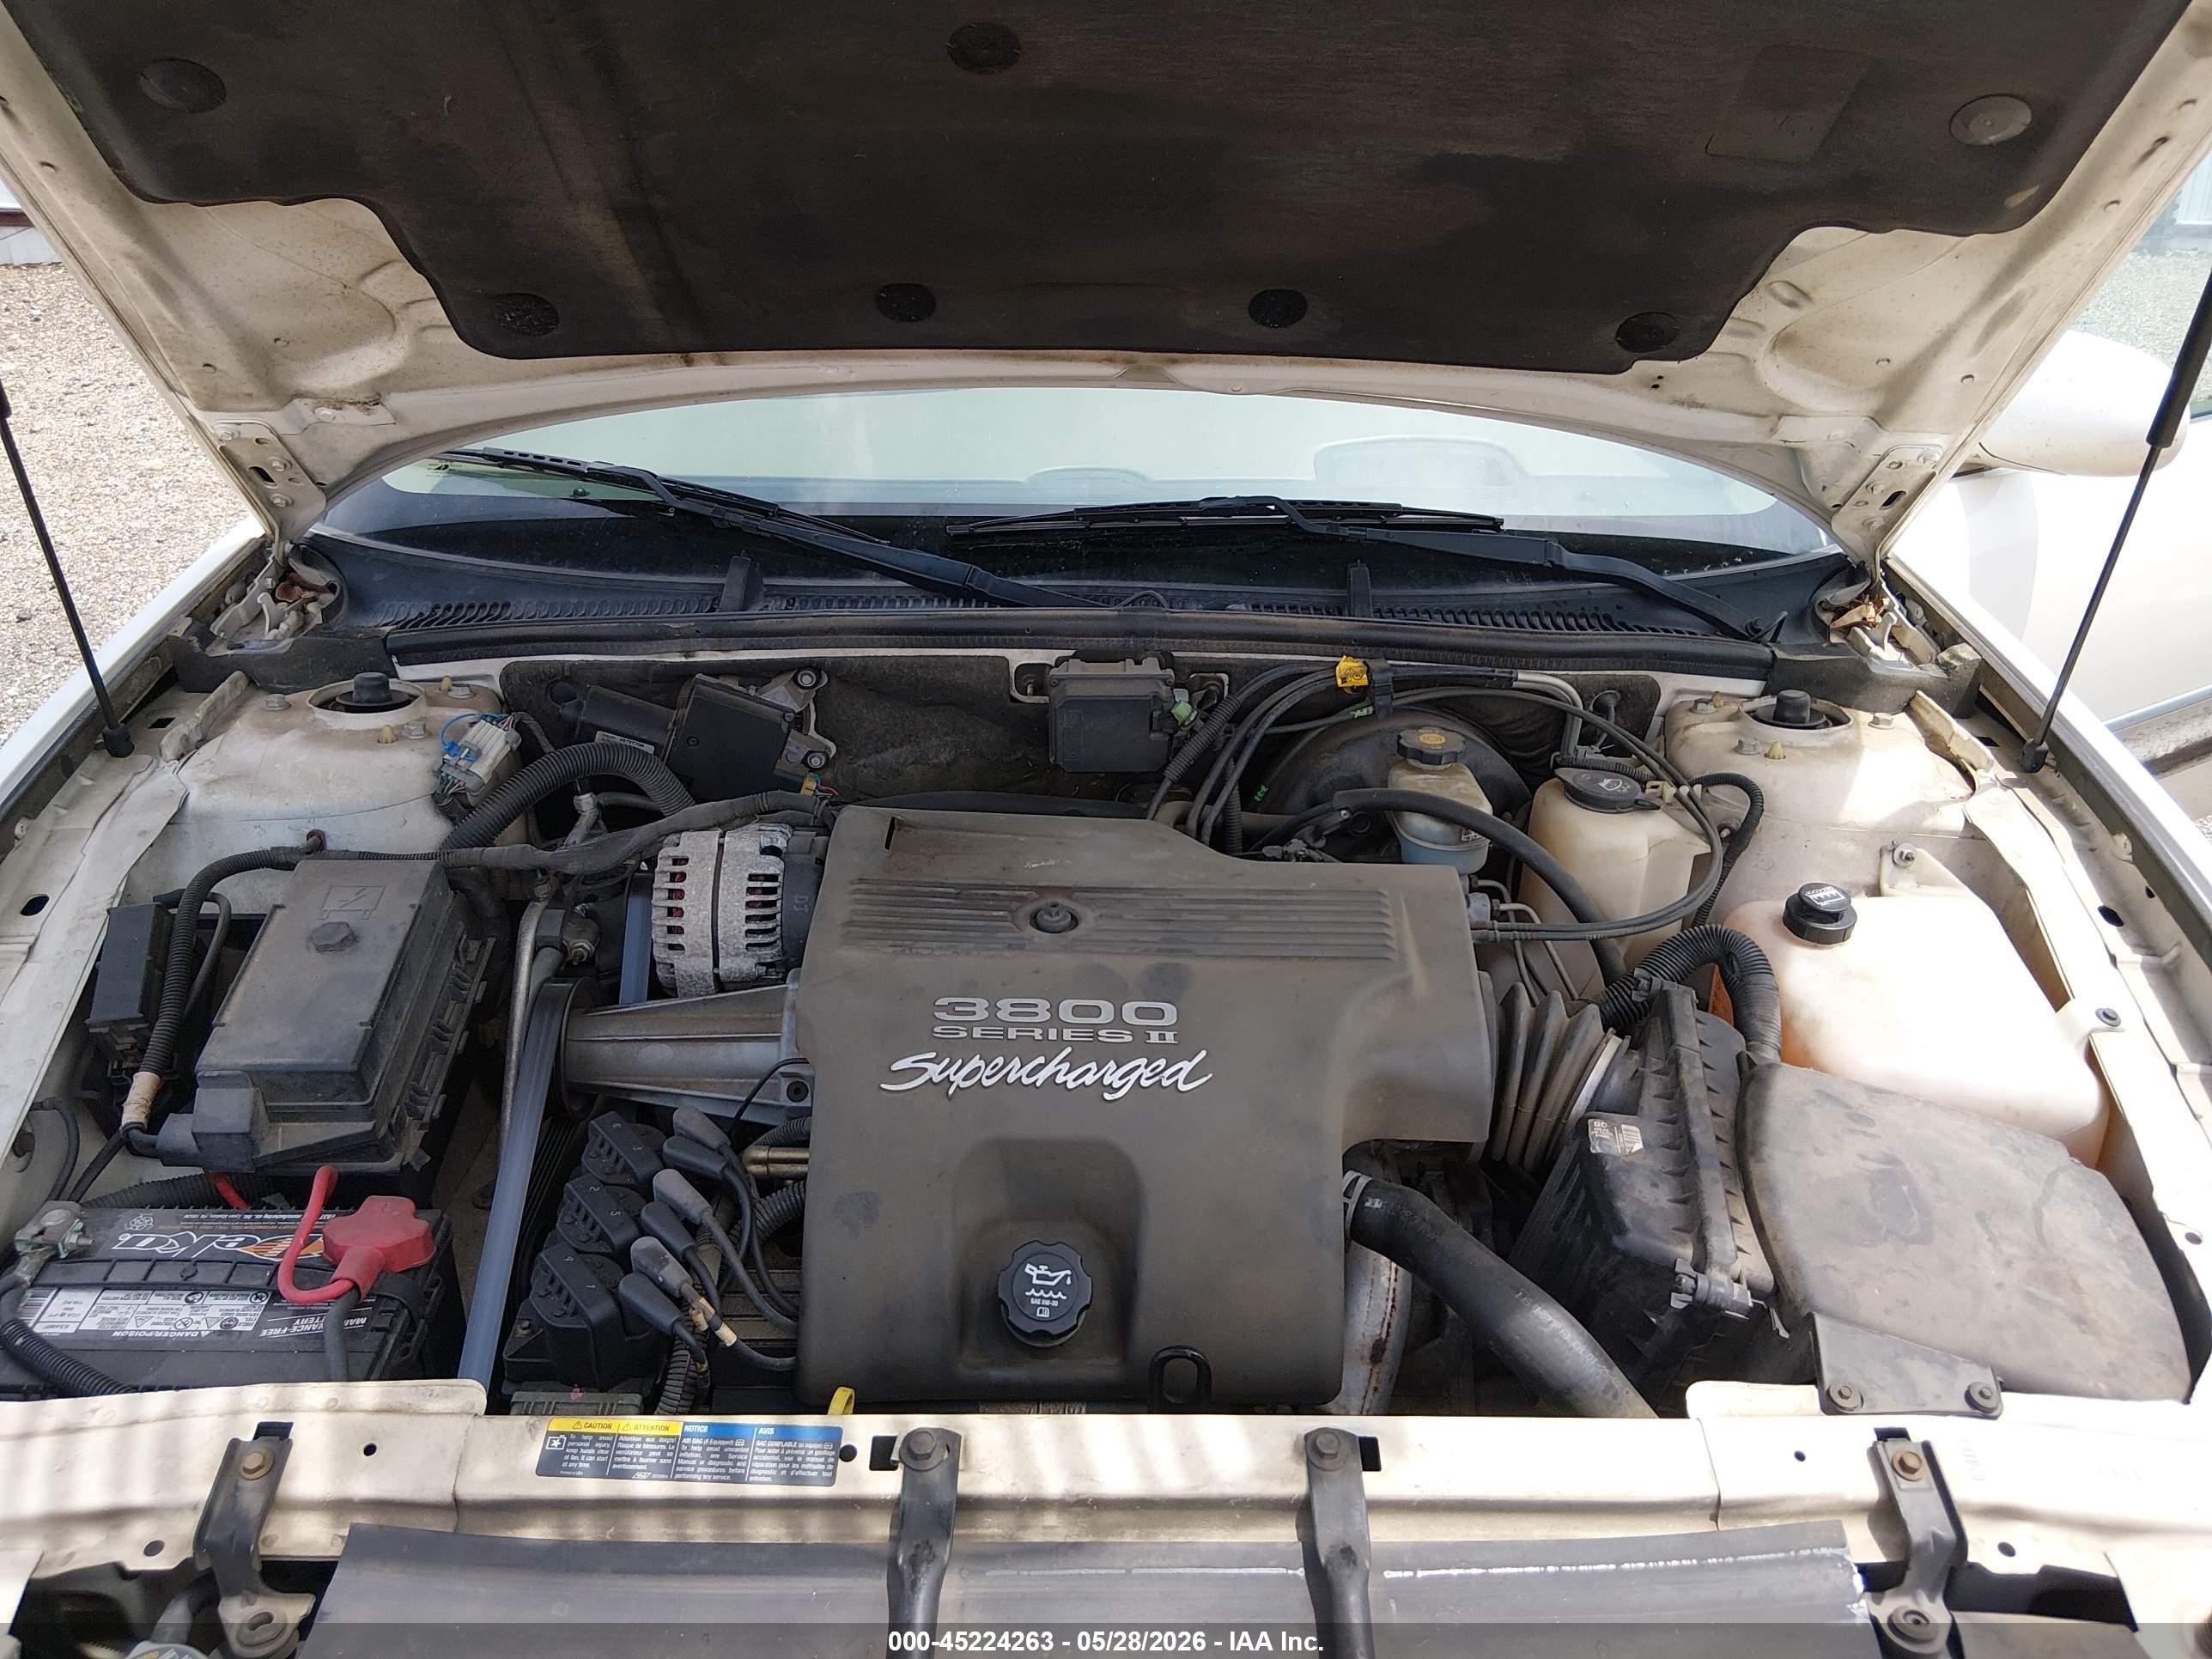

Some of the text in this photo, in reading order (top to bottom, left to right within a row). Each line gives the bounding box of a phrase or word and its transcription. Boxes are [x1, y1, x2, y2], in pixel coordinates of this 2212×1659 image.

[934, 997, 1178, 1026] 3800
[932, 1025, 1179, 1044] SERIES II
[880, 1046, 1213, 1101] Supercharged
